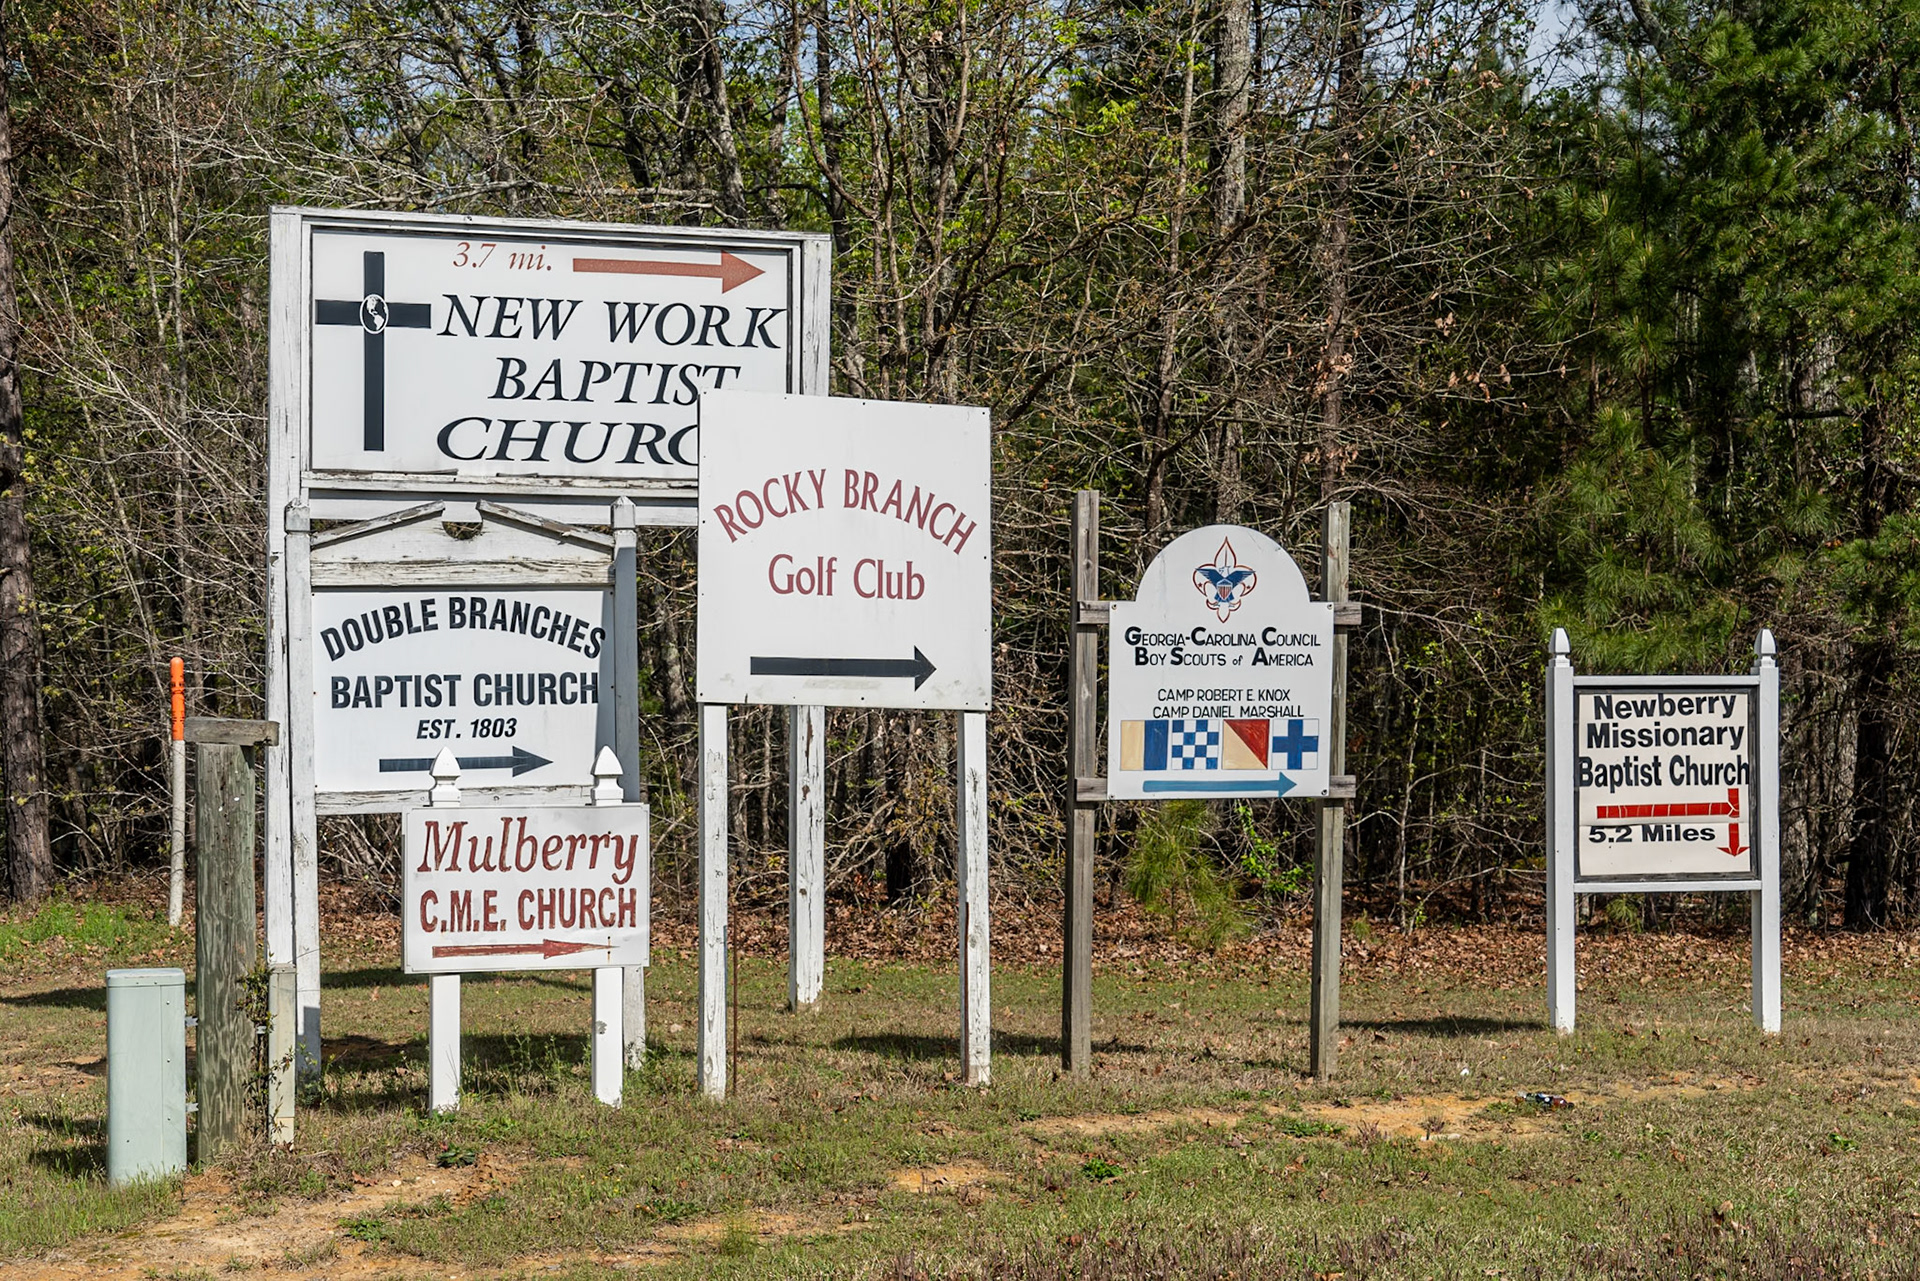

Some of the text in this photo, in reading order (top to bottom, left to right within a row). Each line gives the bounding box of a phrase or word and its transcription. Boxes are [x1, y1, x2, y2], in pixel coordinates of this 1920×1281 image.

[453, 241, 552, 271] 3.7 mi.
[436, 294, 788, 349] NEW WORK
[488, 357, 741, 406] BAPTIST
[437, 416, 698, 466] CHURC
[713, 468, 977, 555] ROCKY BRANCH
[768, 553, 925, 600] Golf Club
[320, 597, 606, 661] DOUBLE BRANCHES
[1261, 626, 1321, 647] COUNCIL
[1134, 647, 1314, 666] BOY SCOUTS of AMERICA
[331, 672, 599, 708] BAPTIST CHURCH
[1157, 688, 1194, 701] CAMP
[1197, 688, 1243, 701] ROBERT
[1258, 688, 1290, 701] KNOX
[1594, 693, 1736, 720] Newberry
[416, 718, 518, 739] EST. 1803
[1152, 705, 1304, 718] CAMP DANIEL MARSHALL
[1587, 722, 1744, 750] Missionary
[1579, 754, 1749, 794] Baptist Church
[417, 817, 639, 885] Mulberry
[1588, 824, 1716, 843] 5.2 Miles
[420, 888, 637, 933] C.M.E. CHURCH
